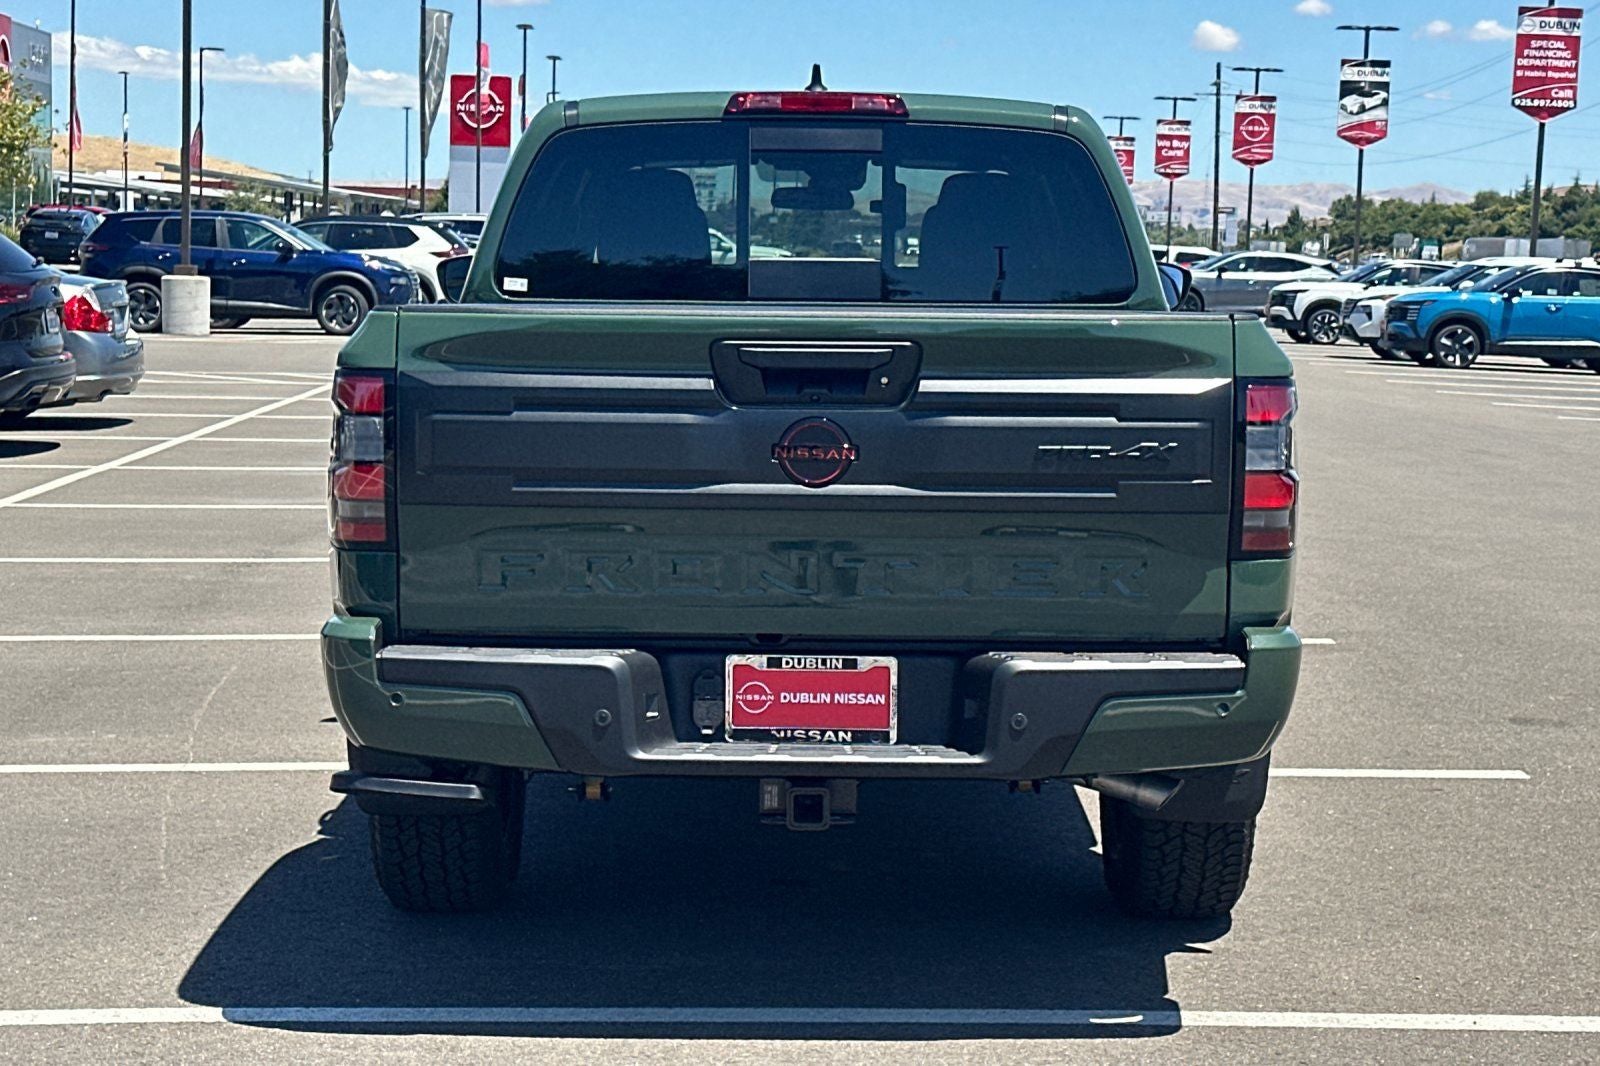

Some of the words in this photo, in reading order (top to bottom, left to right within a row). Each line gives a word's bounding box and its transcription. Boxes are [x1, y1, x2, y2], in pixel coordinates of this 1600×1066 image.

[1539, 20, 1580, 30] DUBLIN
[1530, 40, 1567, 49] SPECIAL
[1523, 49, 1572, 59] FINANCING
[1516, 58, 1577, 68] DEPARTMENT
[456, 104, 505, 112] NISAN
[1156, 139, 1171, 148] We
[1172, 139, 1189, 150] Buy
[774, 447, 856, 460] NISSAN
[477, 551, 1151, 597] FRONTIER
[781, 657, 843, 669] DUBLIN
[735, 693, 775, 701] NISSAN
[780, 692, 831, 704] DUBLIN
[834, 694, 885, 705] NISSAN
[771, 730, 852, 742] NISSAN
